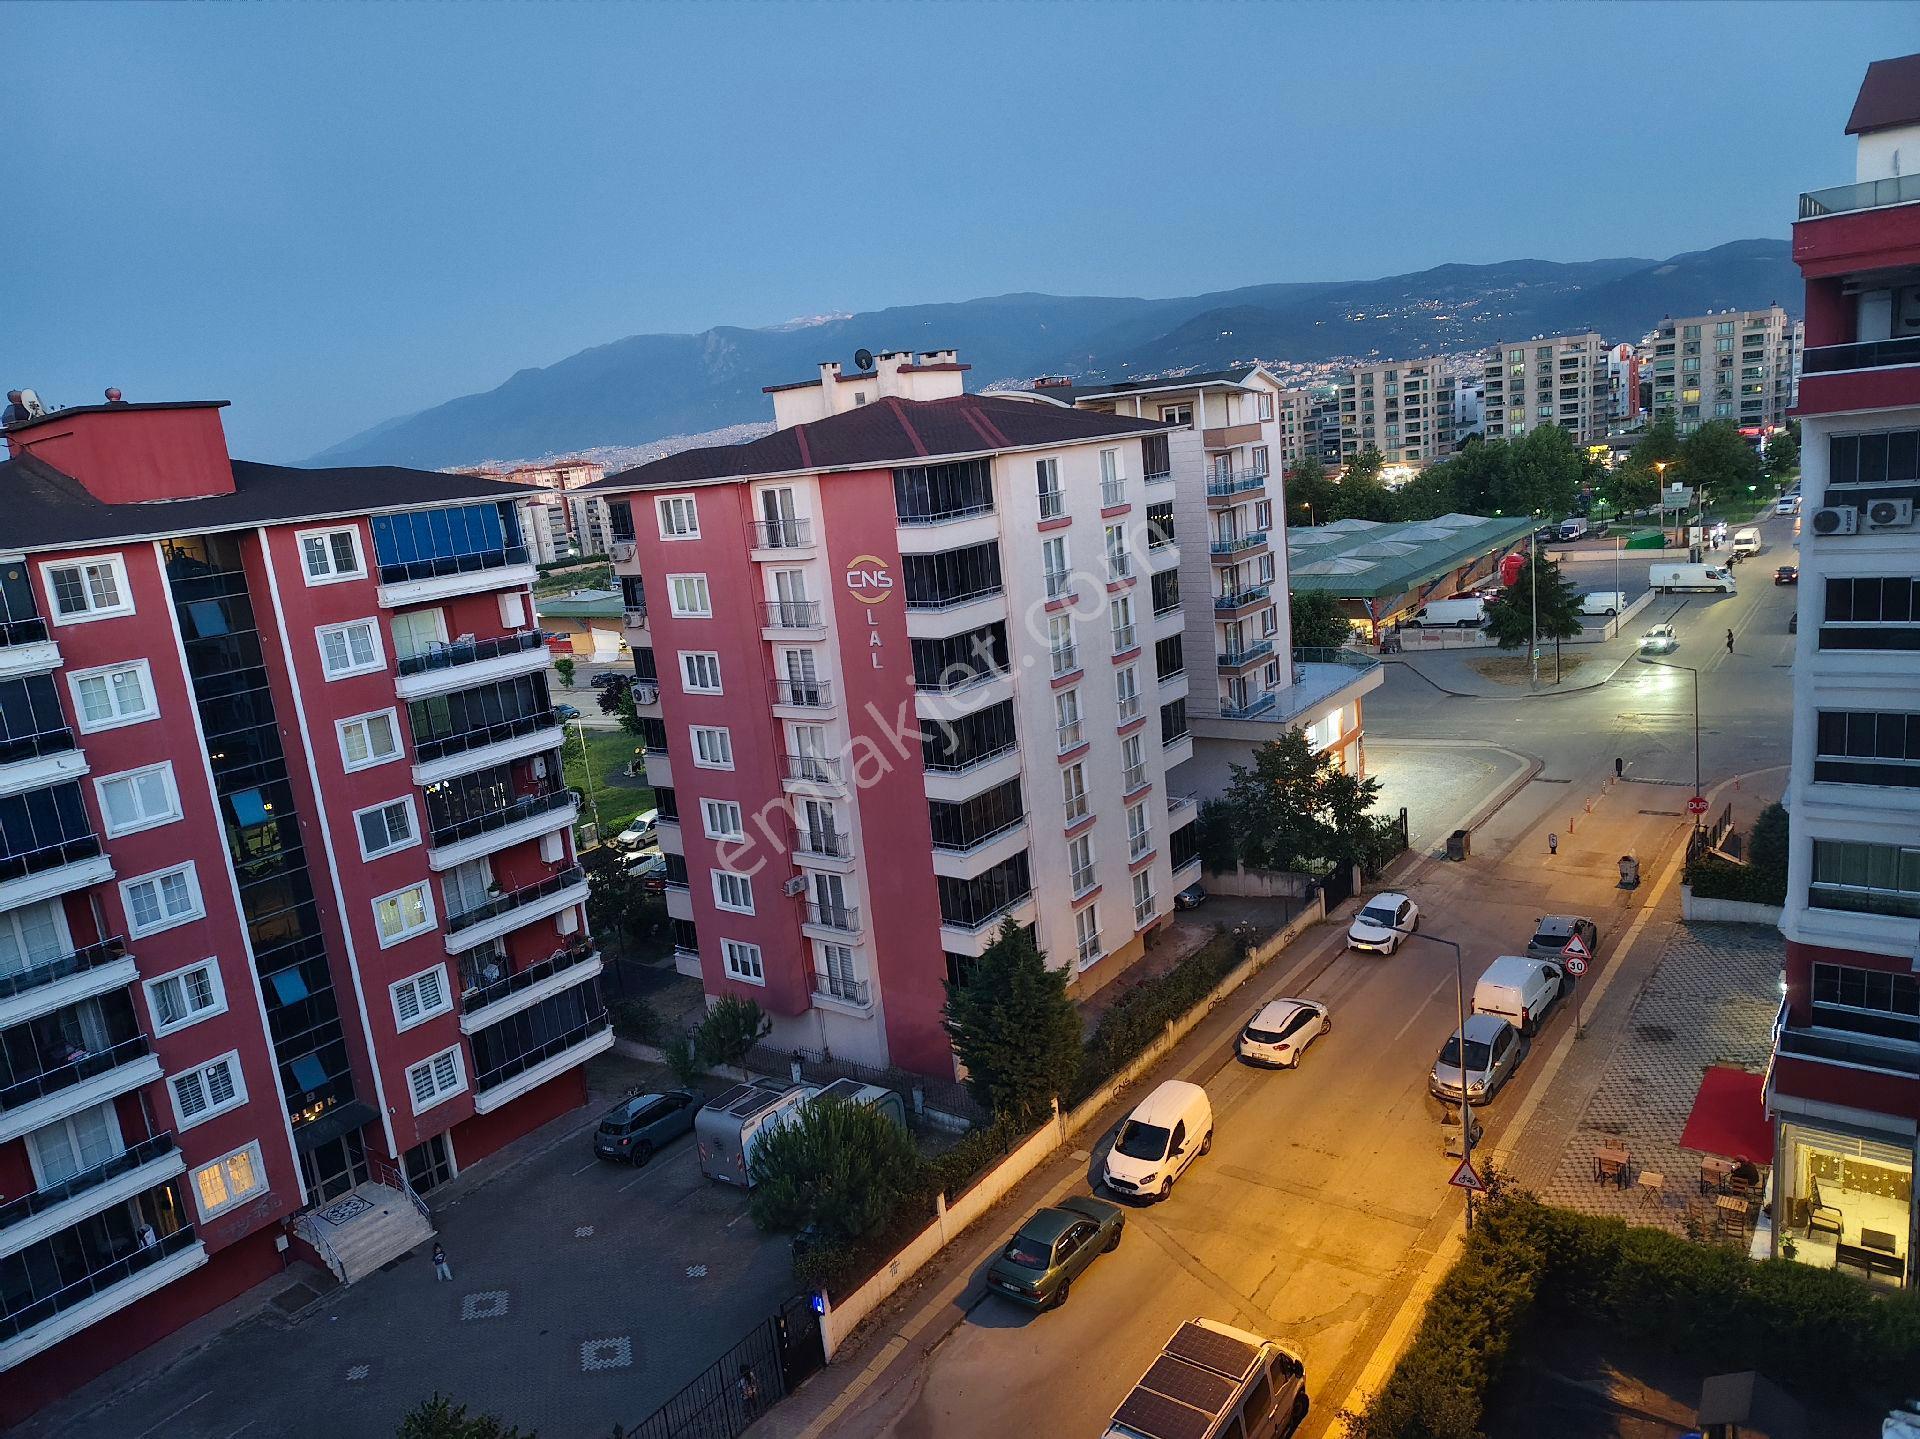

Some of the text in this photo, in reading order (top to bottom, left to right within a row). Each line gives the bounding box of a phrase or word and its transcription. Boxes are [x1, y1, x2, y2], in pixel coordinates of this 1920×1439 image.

[847, 571, 893, 588] CNS
[866, 608, 884, 669] LAL
[1688, 801, 1708, 809] DUR
[1570, 962, 1583, 971] 30
[291, 1095, 337, 1123] BLOK
